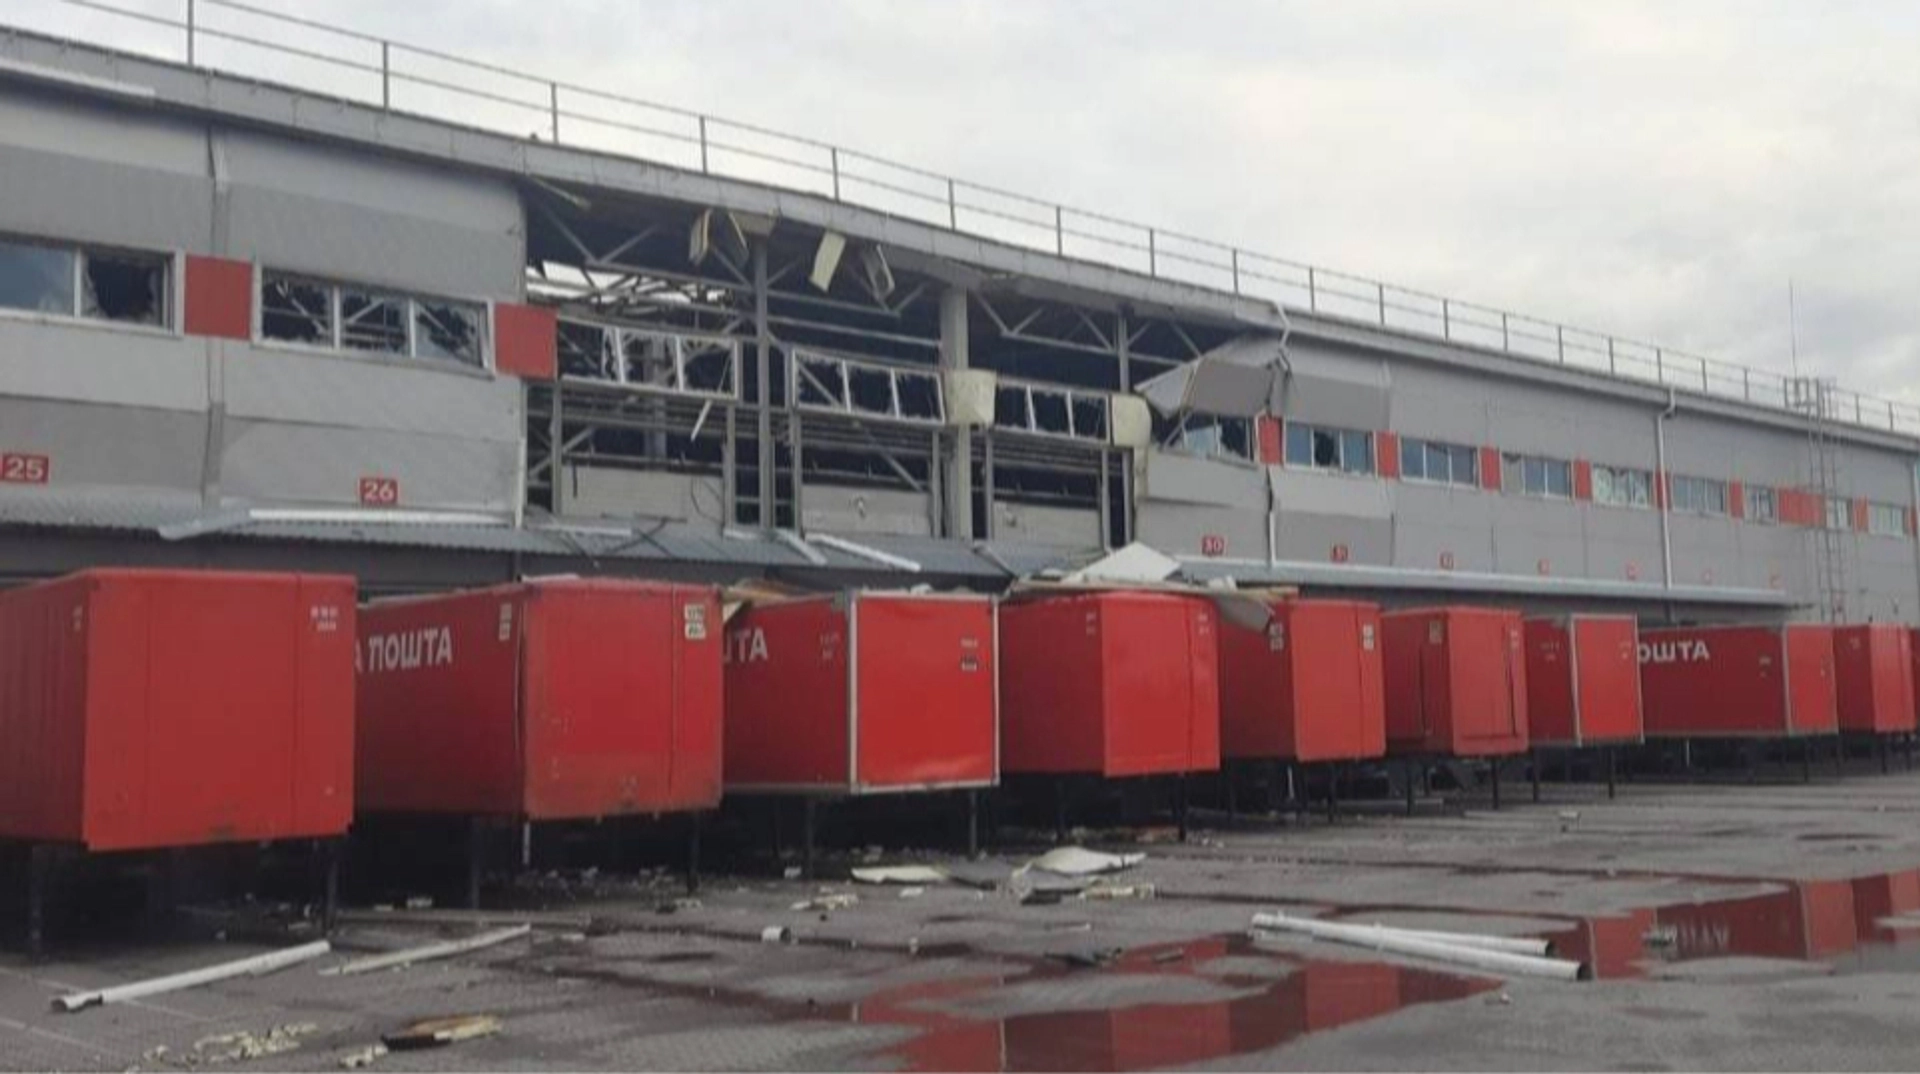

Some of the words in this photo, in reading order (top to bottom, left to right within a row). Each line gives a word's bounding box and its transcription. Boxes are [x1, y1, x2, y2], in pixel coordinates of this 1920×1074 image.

[5, 457, 43, 480] 25
[364, 481, 394, 501] 26
[369, 626, 453, 672] ПОШТА
